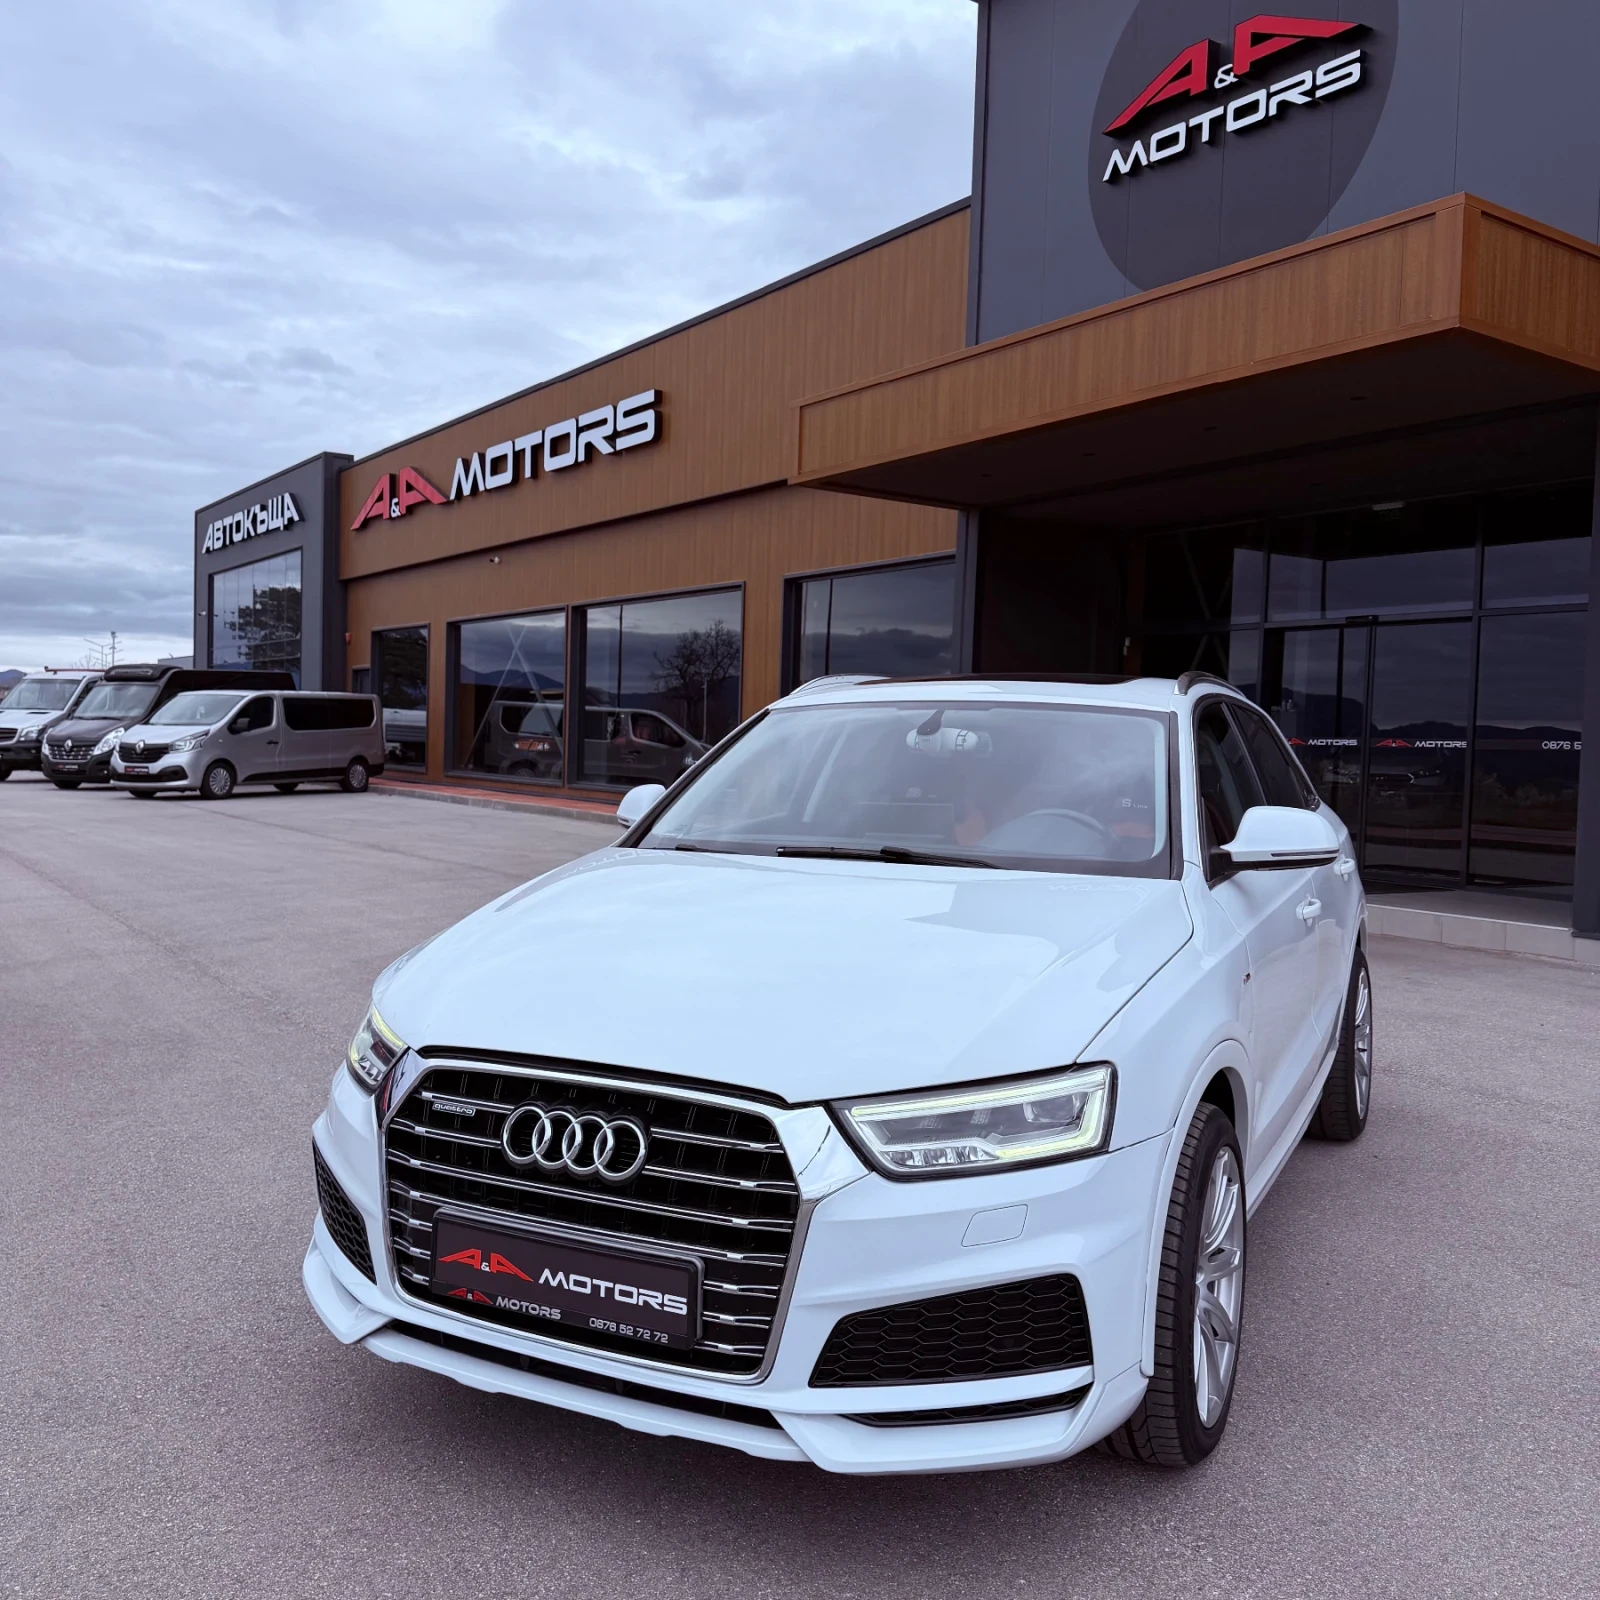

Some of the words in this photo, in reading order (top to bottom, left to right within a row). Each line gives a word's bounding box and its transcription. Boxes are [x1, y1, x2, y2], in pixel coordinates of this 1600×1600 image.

[1103, 49, 1361, 182] MOTORS
[350, 466, 447, 531] A&A
[450, 389, 655, 500] MOTORS
[202, 492, 299, 554] АВТОКЪЩА
[1541, 740, 1571, 750] 0876
[434, 1102, 473, 1115] quattro
[438, 1248, 534, 1282] A&A
[538, 1268, 688, 1316] MOTORS
[496, 1296, 562, 1320] MOTORS
[588, 1317, 617, 1332] 0876
[619, 1323, 634, 1336] 52
[636, 1327, 651, 1340] 72
[653, 1331, 669, 1344] 72
